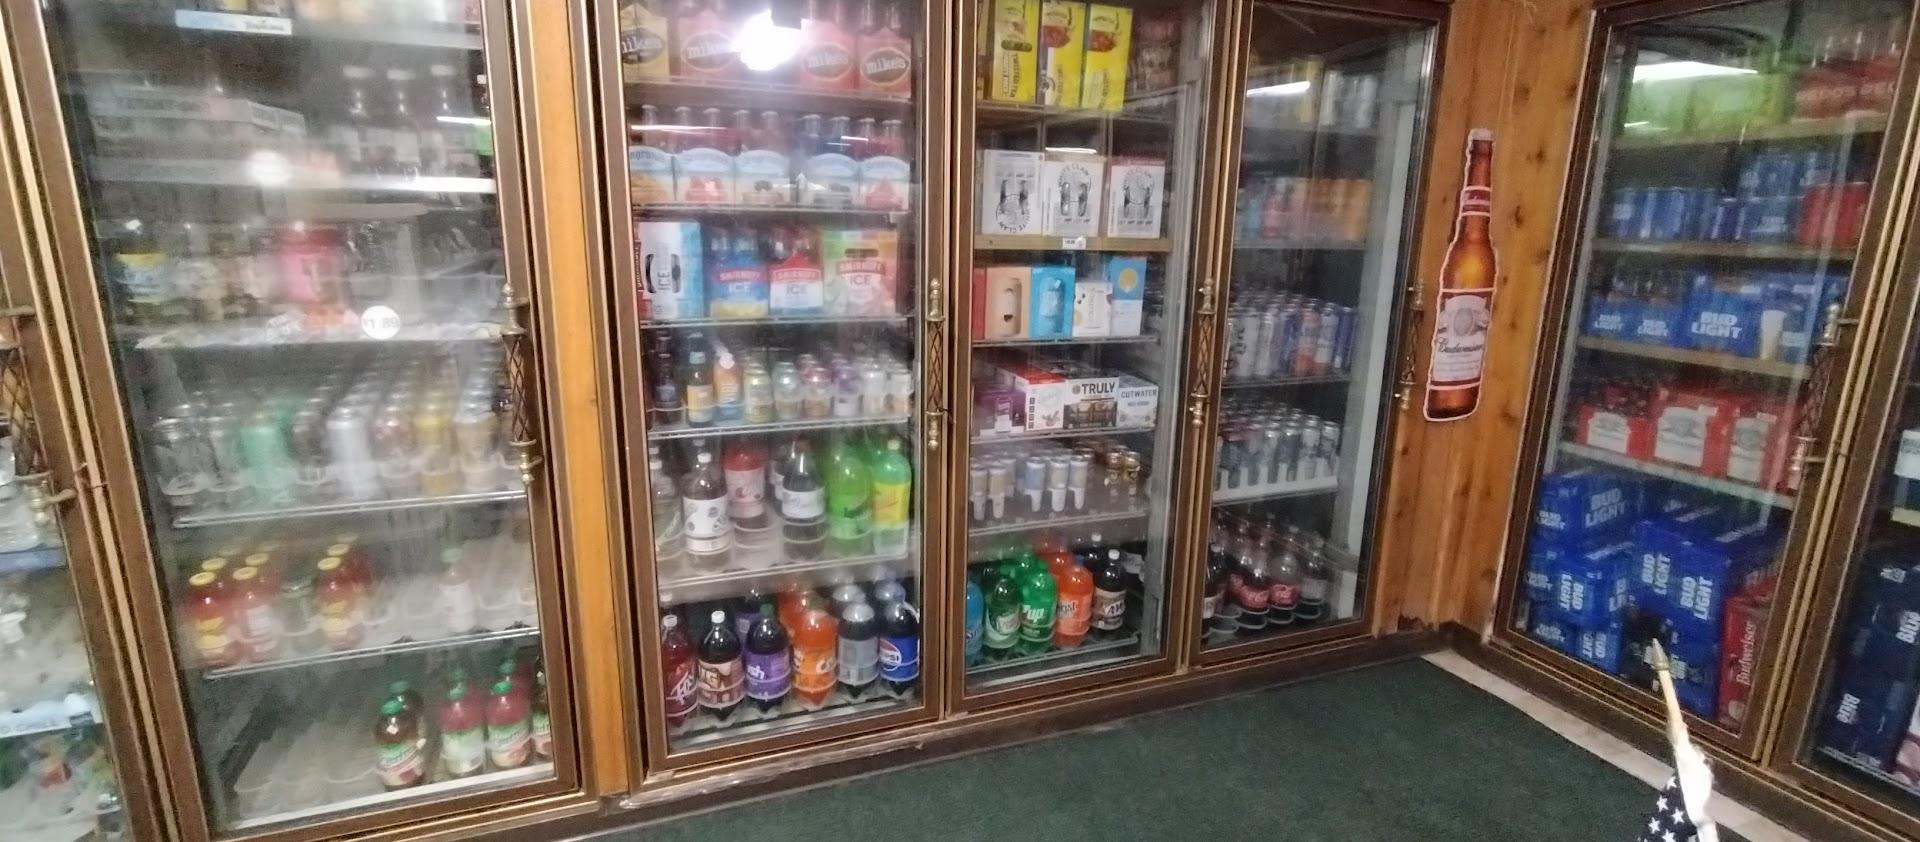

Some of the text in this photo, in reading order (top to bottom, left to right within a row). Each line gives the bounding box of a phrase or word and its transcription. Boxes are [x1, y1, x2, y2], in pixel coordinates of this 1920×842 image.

[786, 284, 809, 295] ICE
[850, 274, 872, 286] ICE
[1691, 321, 1743, 339] LIGHT
[1700, 311, 1738, 326] BUD
[1081, 381, 1116, 395] TRULY
[1121, 389, 1158, 398] CUTWATER
[1591, 487, 1622, 511] BUD
[1642, 553, 1656, 584] BUD
[1653, 553, 1670, 595] LIGHT
[1560, 573, 1572, 611] LIGHT
[1572, 582, 1584, 610] BUD
[1680, 576, 1696, 608] BUD
[1693, 576, 1713, 620] LIGHT
[1736, 620, 1757, 686] Budweiser
